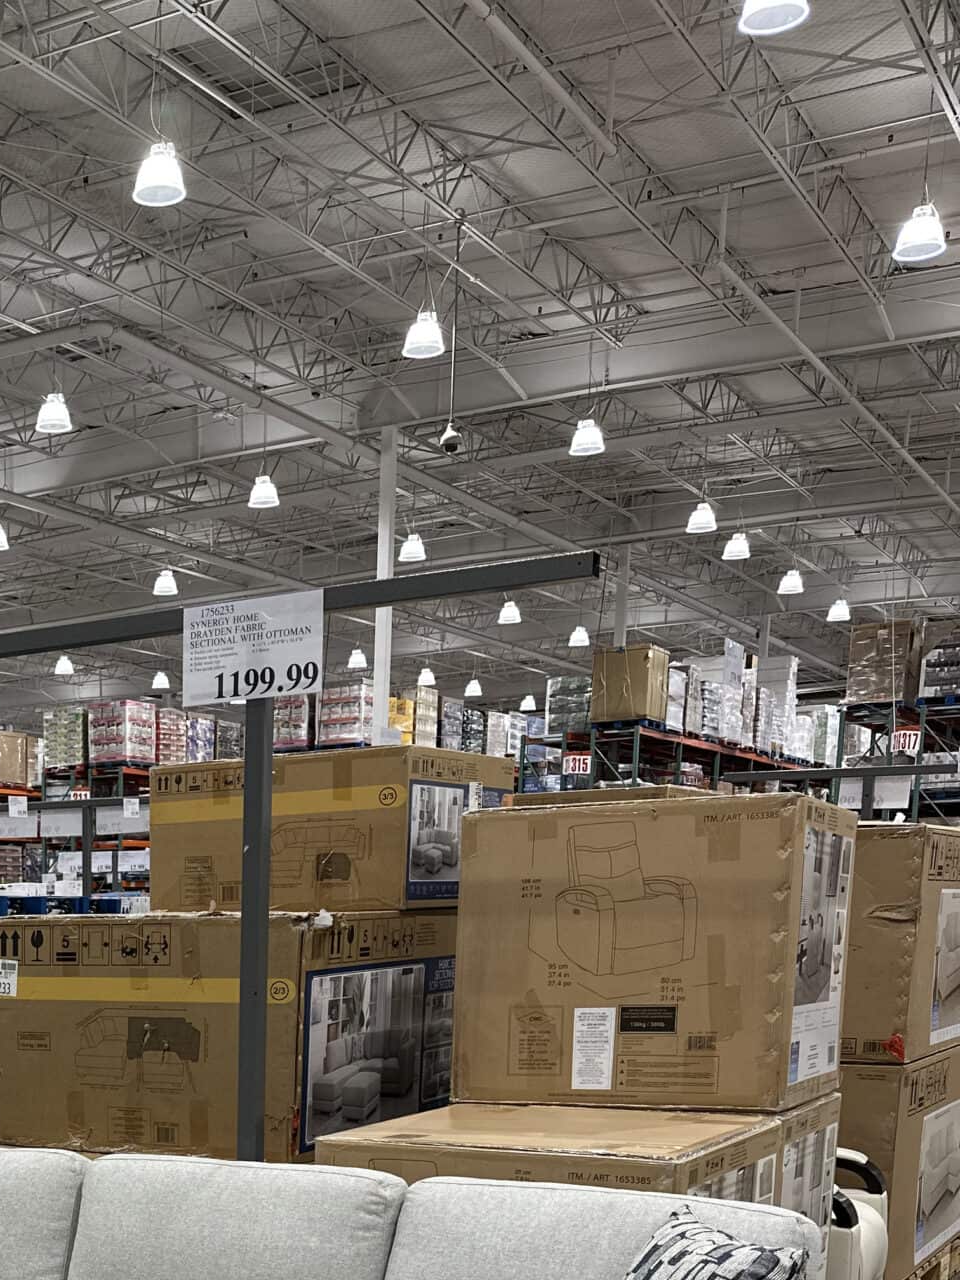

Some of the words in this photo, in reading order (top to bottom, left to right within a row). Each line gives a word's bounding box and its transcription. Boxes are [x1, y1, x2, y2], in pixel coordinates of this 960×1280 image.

[200, 605, 235, 618] 1756233
[190, 617, 230, 630] SYNERGY
[233, 612, 259, 623] HOME
[190, 626, 232, 640] DRAYDEN
[235, 621, 267, 634] FABRIC
[190, 636, 238, 649] SECTIONAL
[240, 630, 264, 642] WITH
[265, 625, 312, 639] OTTOMAN
[215, 660, 320, 699] 1199.99
[571, 757, 589, 773] 315
[272, 986, 287, 996] 2/3
[615, 1175, 652, 1185] 1653385
